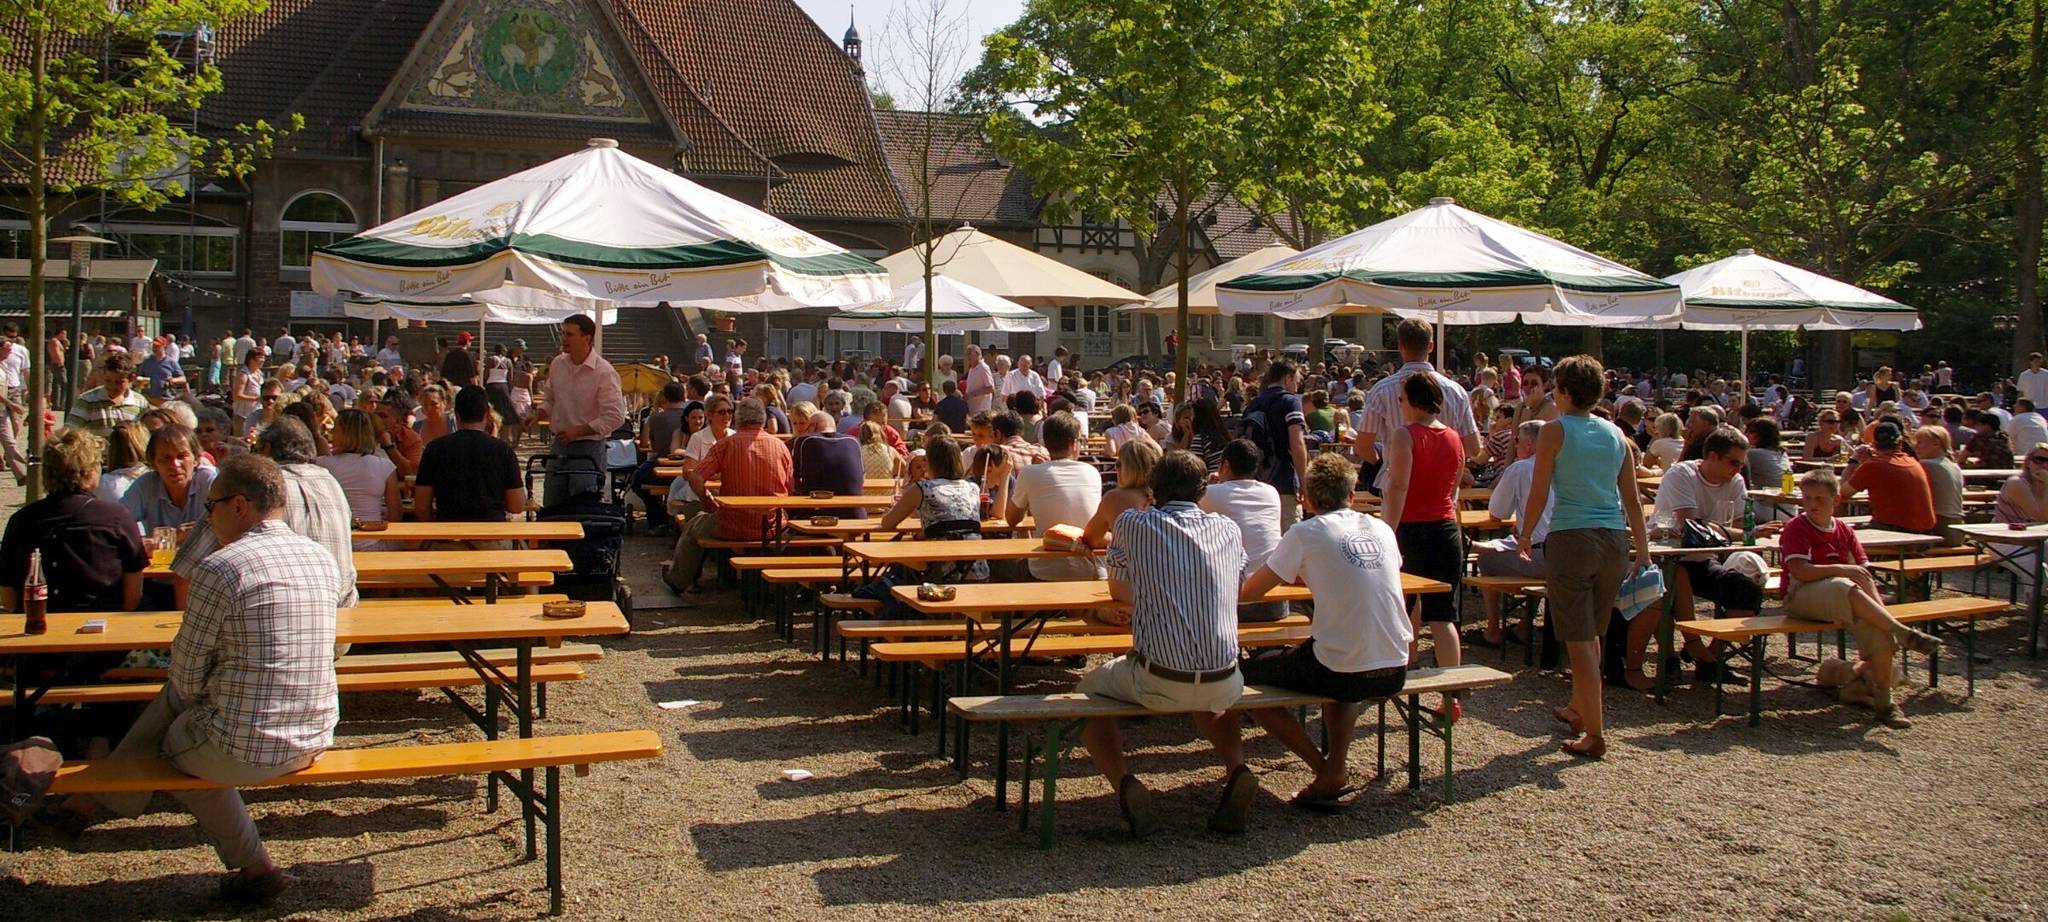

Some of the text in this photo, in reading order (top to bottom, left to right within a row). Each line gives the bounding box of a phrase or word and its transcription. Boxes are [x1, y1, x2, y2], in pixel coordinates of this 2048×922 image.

[605, 272, 670, 294] Bitte ein Bit
[1417, 297, 1437, 307] Bitte
[1454, 290, 1470, 300] Bit
